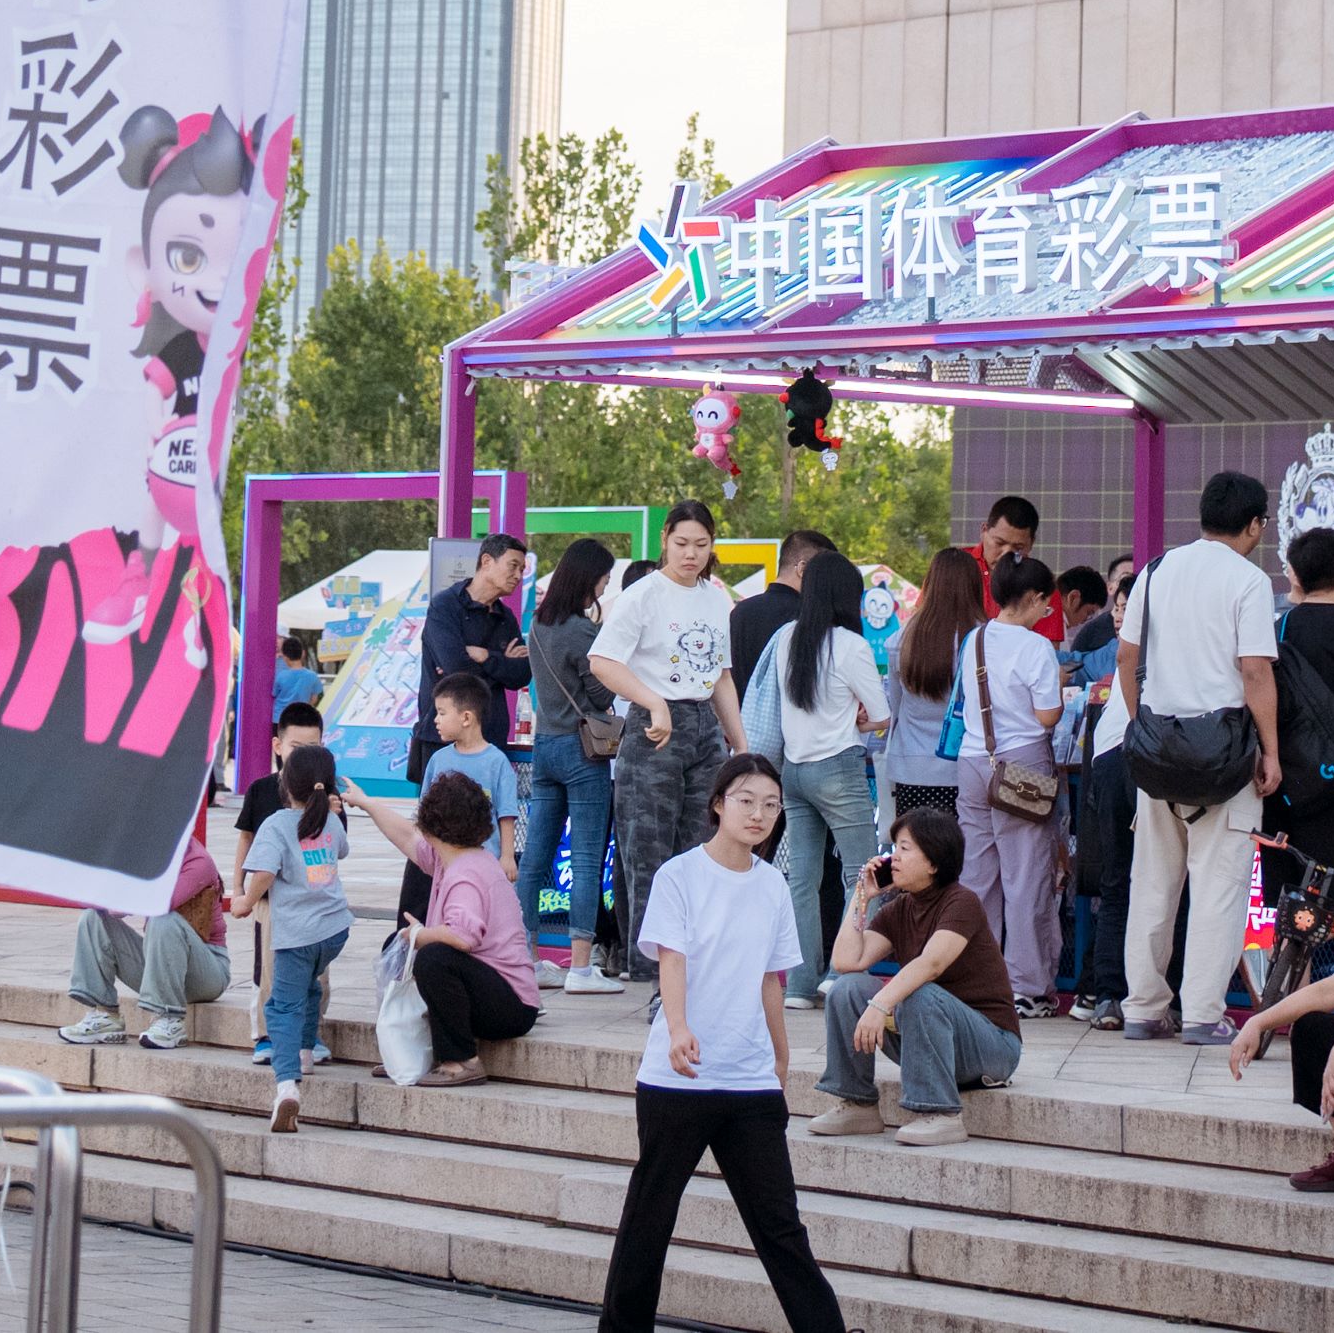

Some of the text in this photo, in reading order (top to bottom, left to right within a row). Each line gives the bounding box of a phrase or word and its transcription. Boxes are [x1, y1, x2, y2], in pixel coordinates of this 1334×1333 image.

[730, 171, 1229, 307] 中国体育彩票
[168, 439, 196, 457] NE
